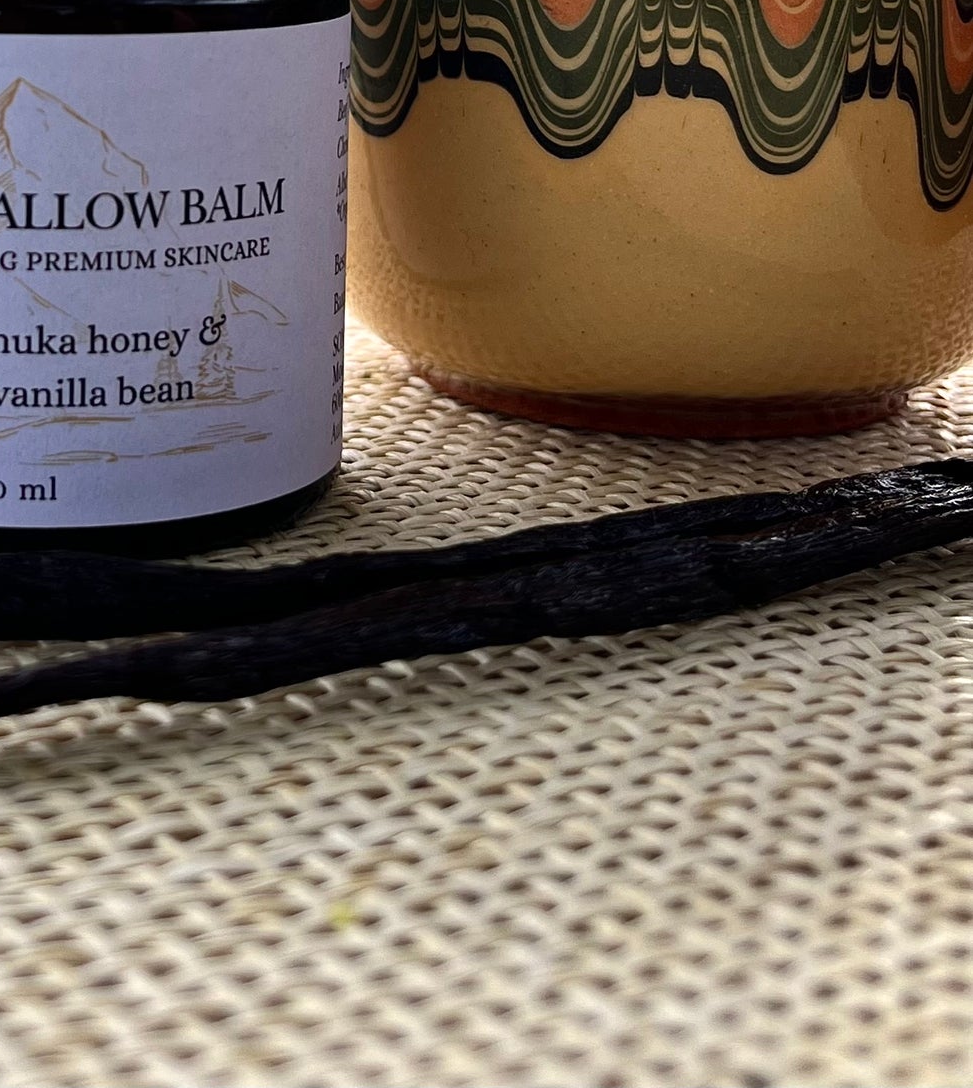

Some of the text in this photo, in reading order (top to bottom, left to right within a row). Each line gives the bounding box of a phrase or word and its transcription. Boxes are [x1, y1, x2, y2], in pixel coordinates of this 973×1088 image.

[179, 177, 287, 227] BALM
[26, 248, 157, 273] PREMIUM
[163, 236, 272, 270] SKINCARE
[86, 323, 191, 359] honey
[199, 314, 229, 348] &
[117, 373, 196, 408] bean
[18, 475, 59, 503] ml
